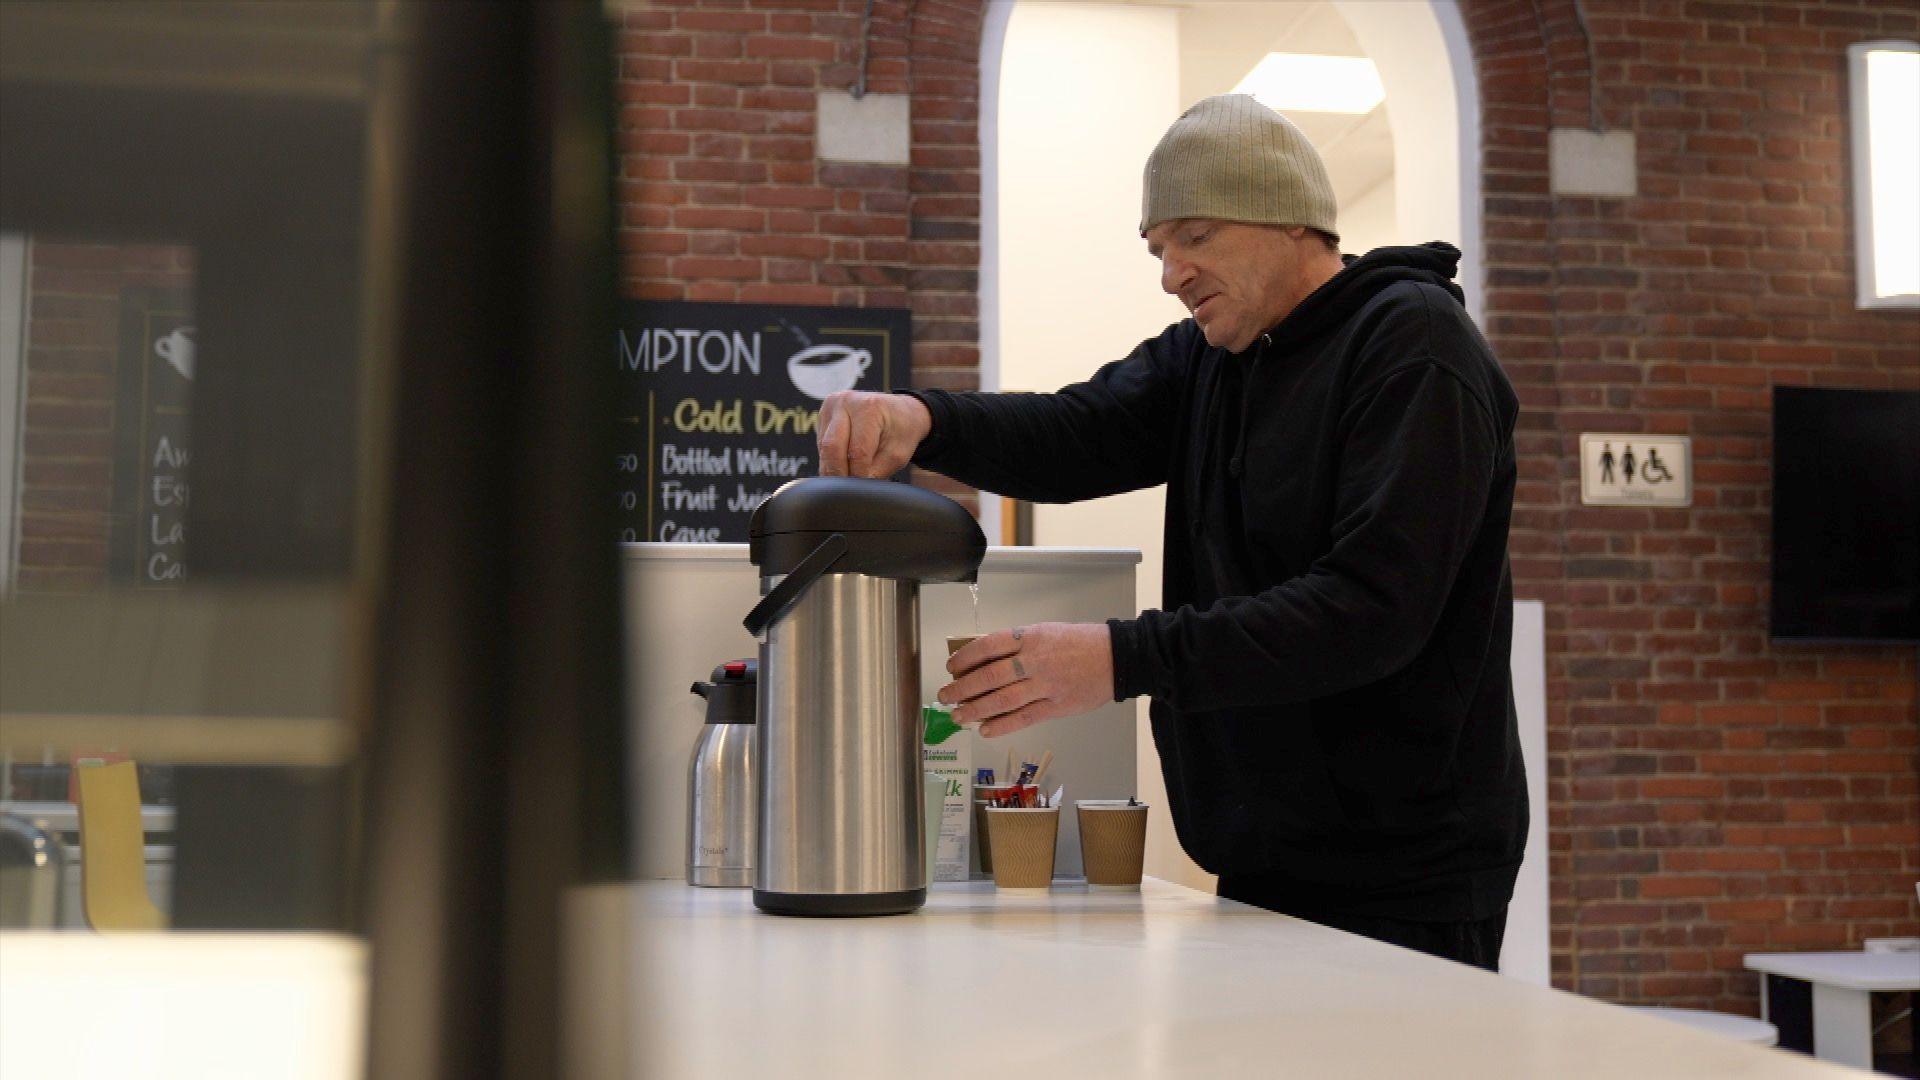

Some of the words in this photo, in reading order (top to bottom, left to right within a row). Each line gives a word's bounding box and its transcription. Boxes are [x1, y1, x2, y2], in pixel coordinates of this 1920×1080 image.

[673, 398, 743, 434] Cold
[662, 443, 732, 476] Bottled
[736, 447, 808, 476] Water
[661, 480, 719, 511] Fruit
[660, 520, 721, 543] Cans
